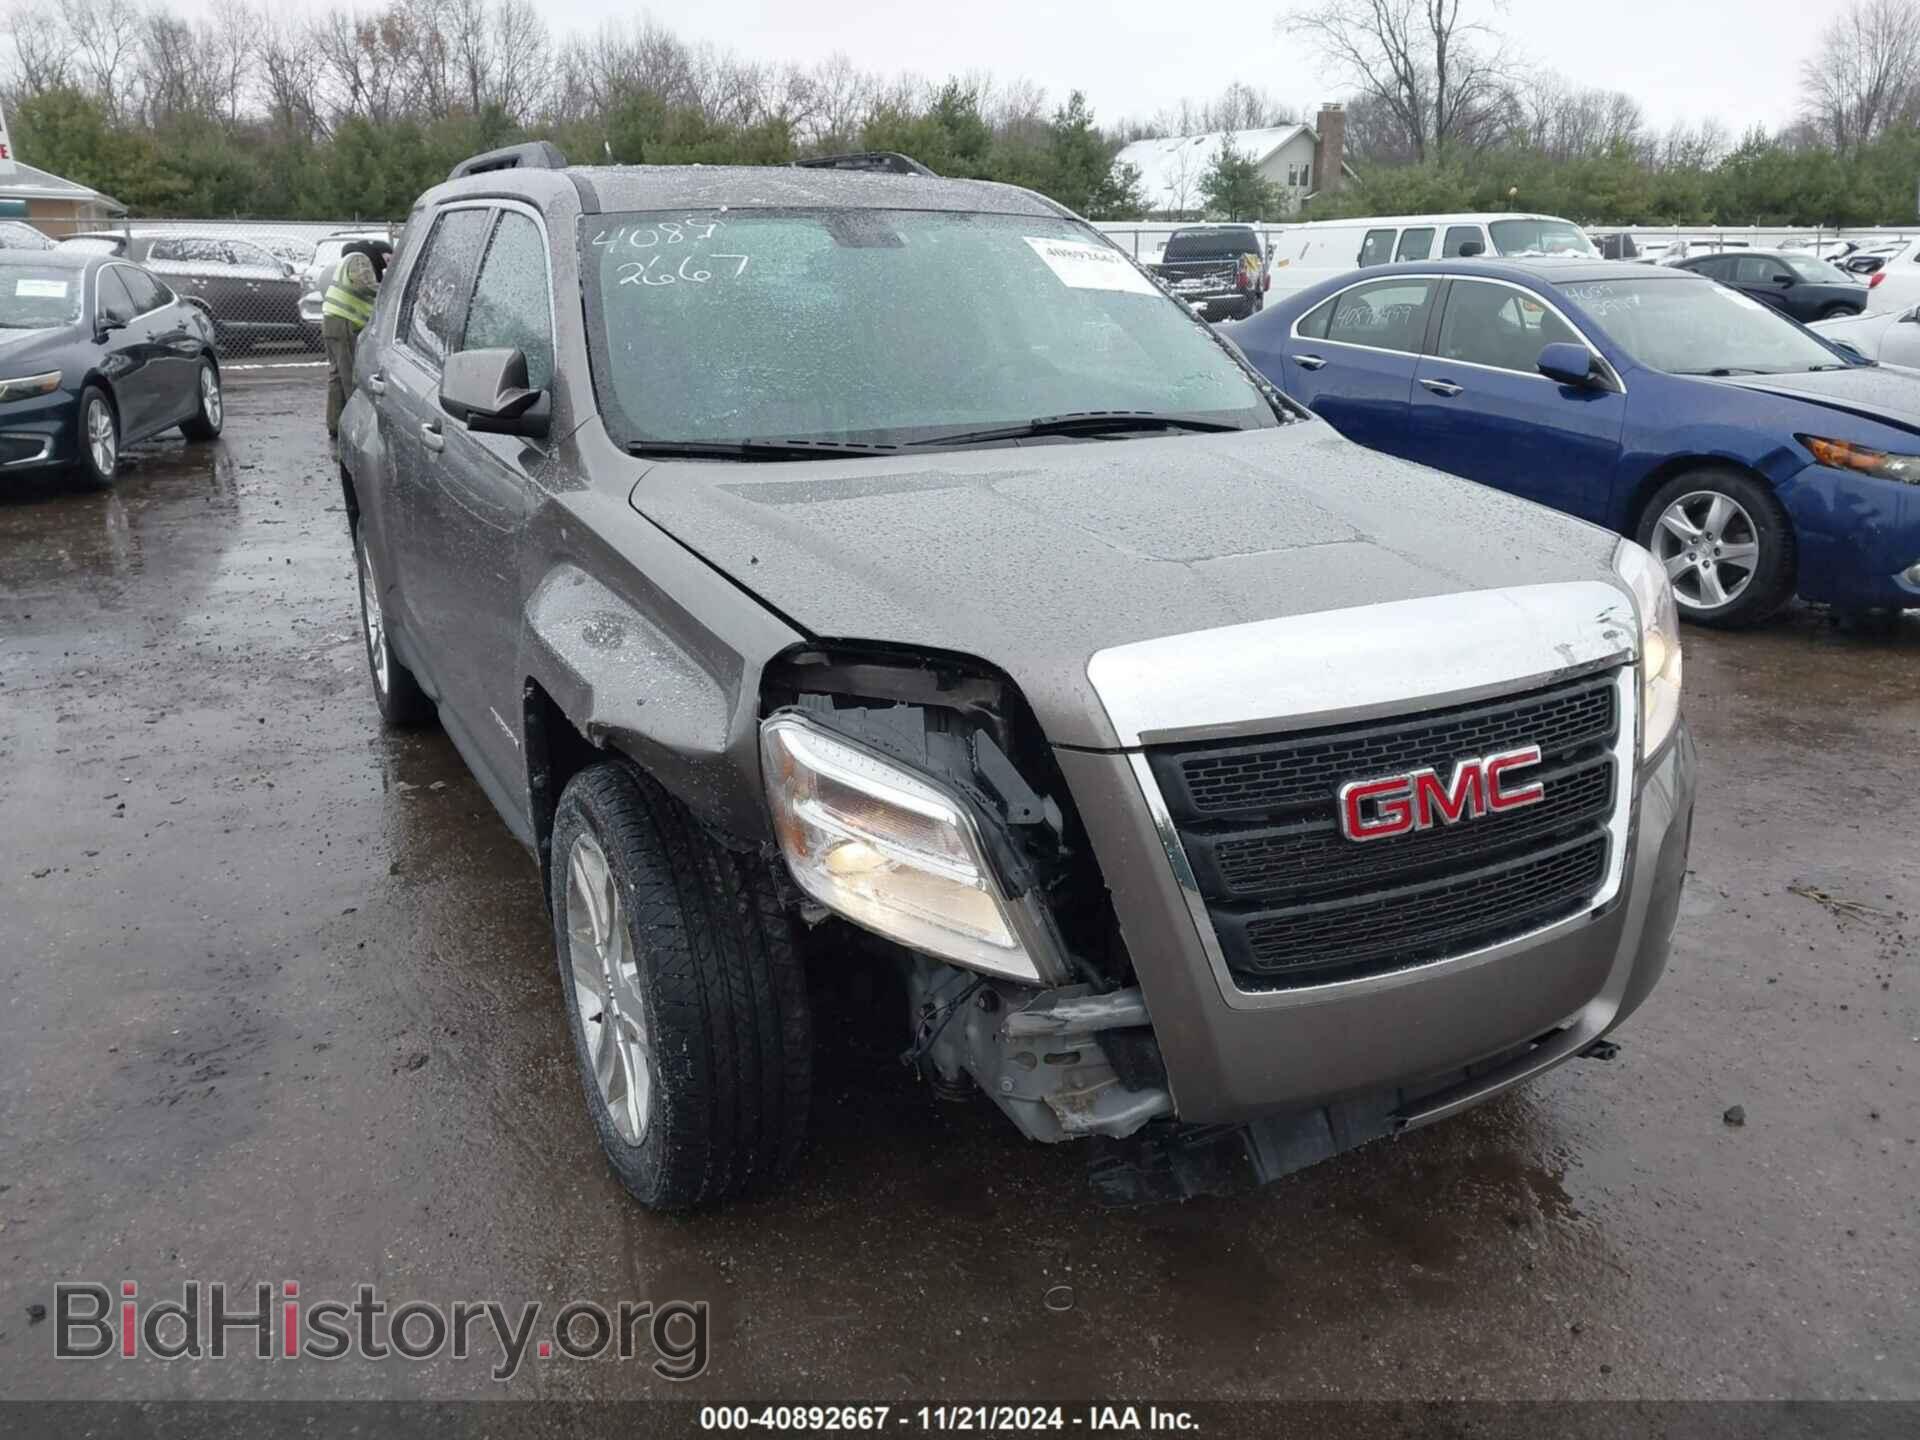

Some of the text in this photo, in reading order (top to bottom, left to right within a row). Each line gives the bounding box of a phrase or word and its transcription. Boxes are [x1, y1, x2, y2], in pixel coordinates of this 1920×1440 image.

[592, 214, 718, 254] 4089
[616, 254, 749, 286] 2667
[1339, 744, 1544, 842] GMC
